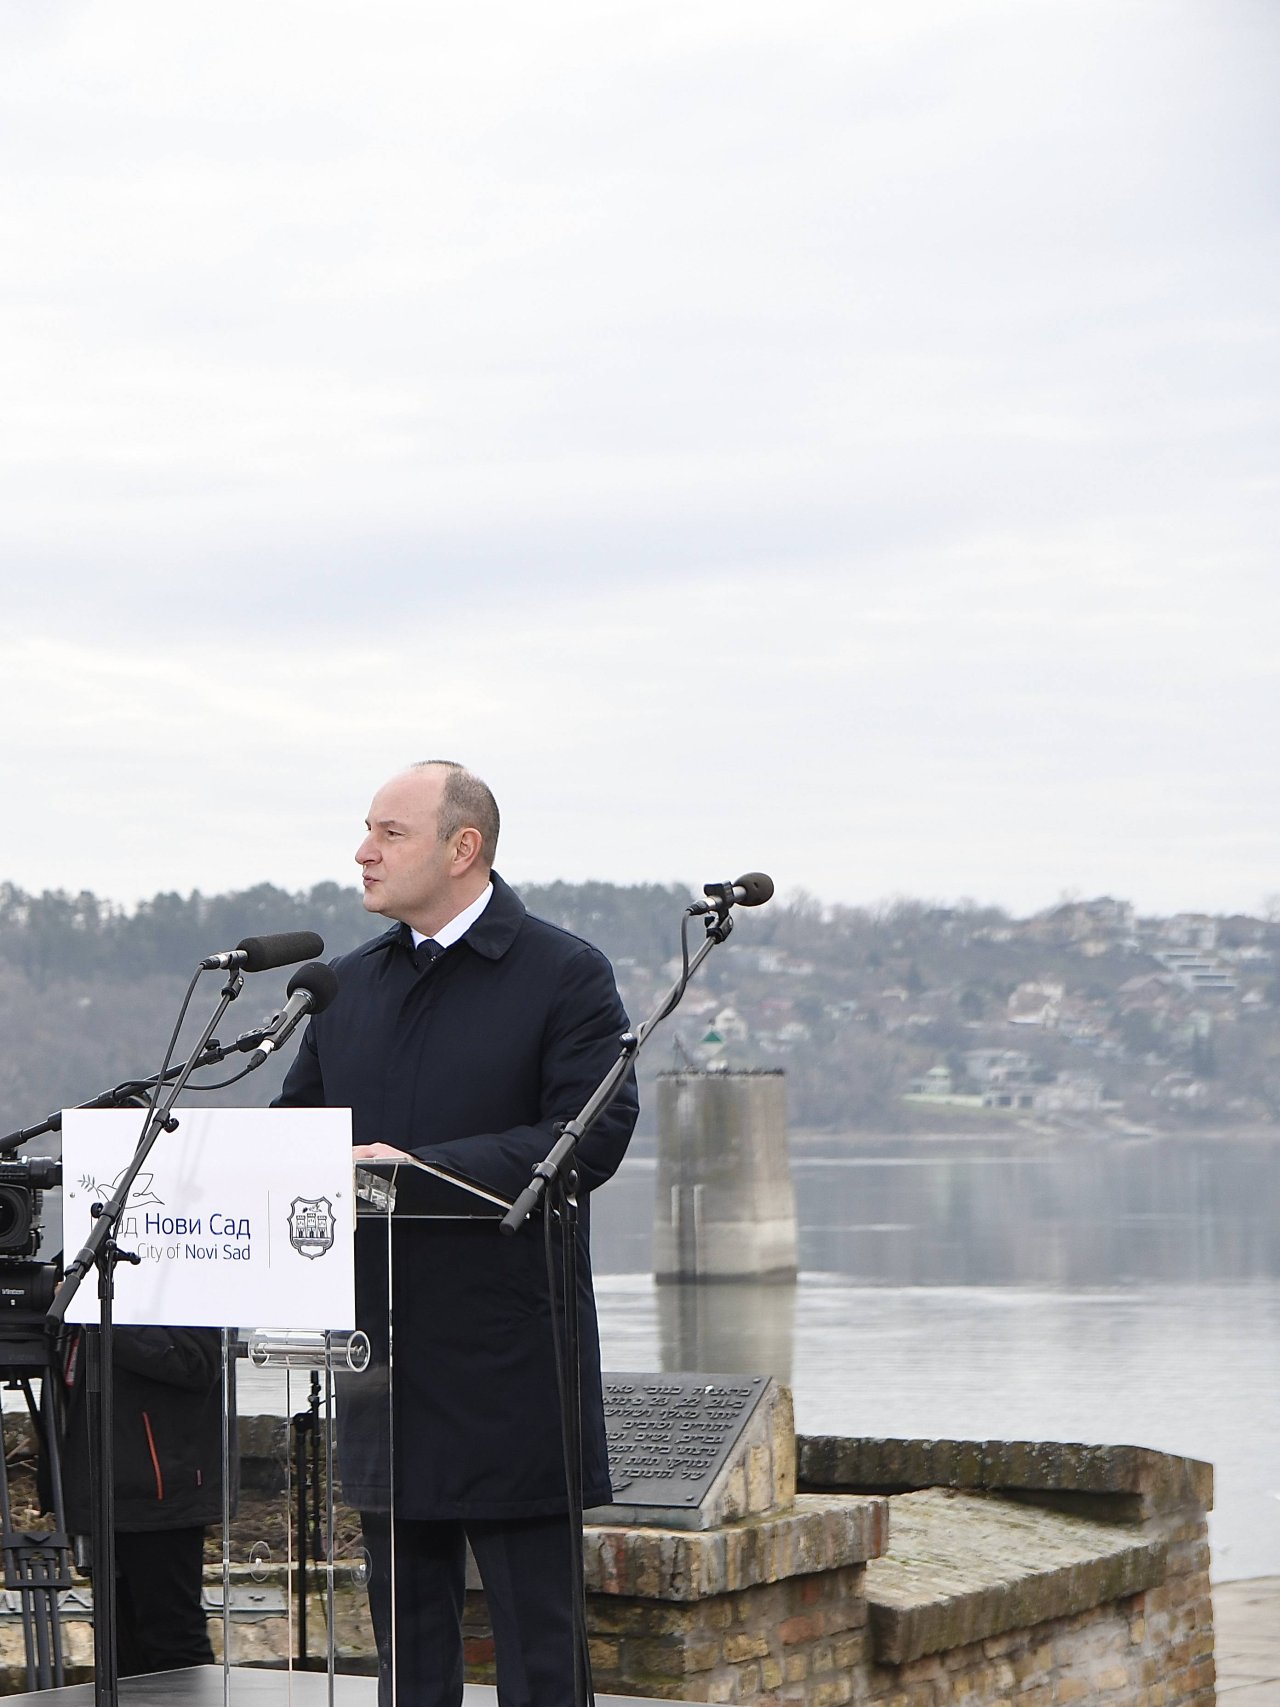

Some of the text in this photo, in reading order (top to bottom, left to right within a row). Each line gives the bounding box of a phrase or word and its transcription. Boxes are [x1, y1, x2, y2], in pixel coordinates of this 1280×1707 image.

[145, 1212, 201, 1235] Нови
[209, 1213, 251, 1240] Сад
[137, 1243, 251, 1263] City of Novi Sad
[648, 1397, 670, 1406] 23
